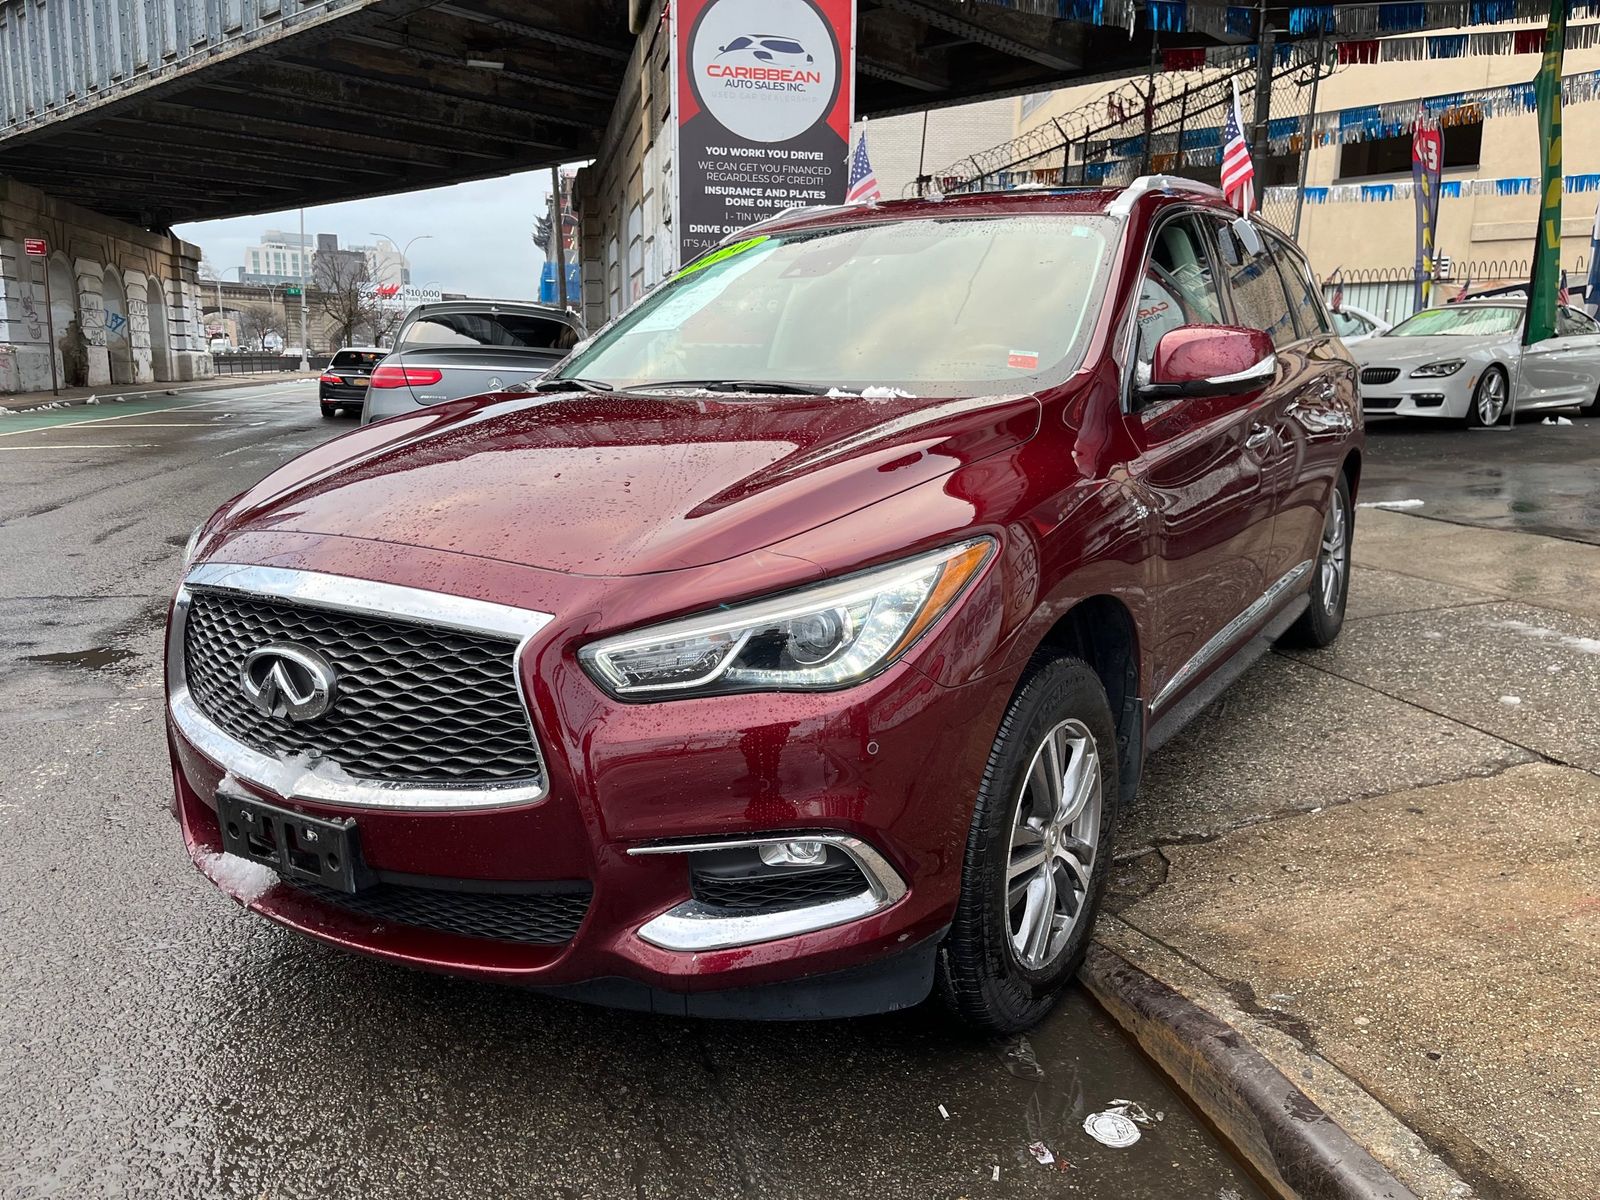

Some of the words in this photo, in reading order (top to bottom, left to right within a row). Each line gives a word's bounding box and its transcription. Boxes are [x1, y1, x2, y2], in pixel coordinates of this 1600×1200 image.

[706, 64, 821, 84] CARIBBEAN
[725, 79, 753, 89] AUTO
[754, 81, 785, 91] SALES
[787, 83, 806, 92] INC.
[705, 146, 728, 156] YOU
[730, 147, 765, 158] WORK!
[767, 149, 788, 159] YOU
[791, 151, 824, 161] DRIVE!
[698, 161, 714, 170] WE
[716, 162, 738, 171] CAN
[739, 163, 758, 172] GET
[760, 164, 780, 173] YOU
[782, 165, 832, 176] FINANCED
[706, 172, 770, 183] REGARDLESS
[771, 175, 785, 183] OF
[787, 175, 824, 186] CREDIT!
[704, 185, 763, 197] INSURANCE
[765, 188, 787, 198] AND
[789, 190, 826, 199] PLATES
[725, 198, 755, 207] DONE
[756, 199, 773, 208] ON
[773, 200, 806, 209] SIGHT!
[735, 212, 752, 221] TIN
[689, 224, 721, 234] DRIVE
[683, 239, 700, 248] IT'S
[405, 288, 440, 299] $10,000
